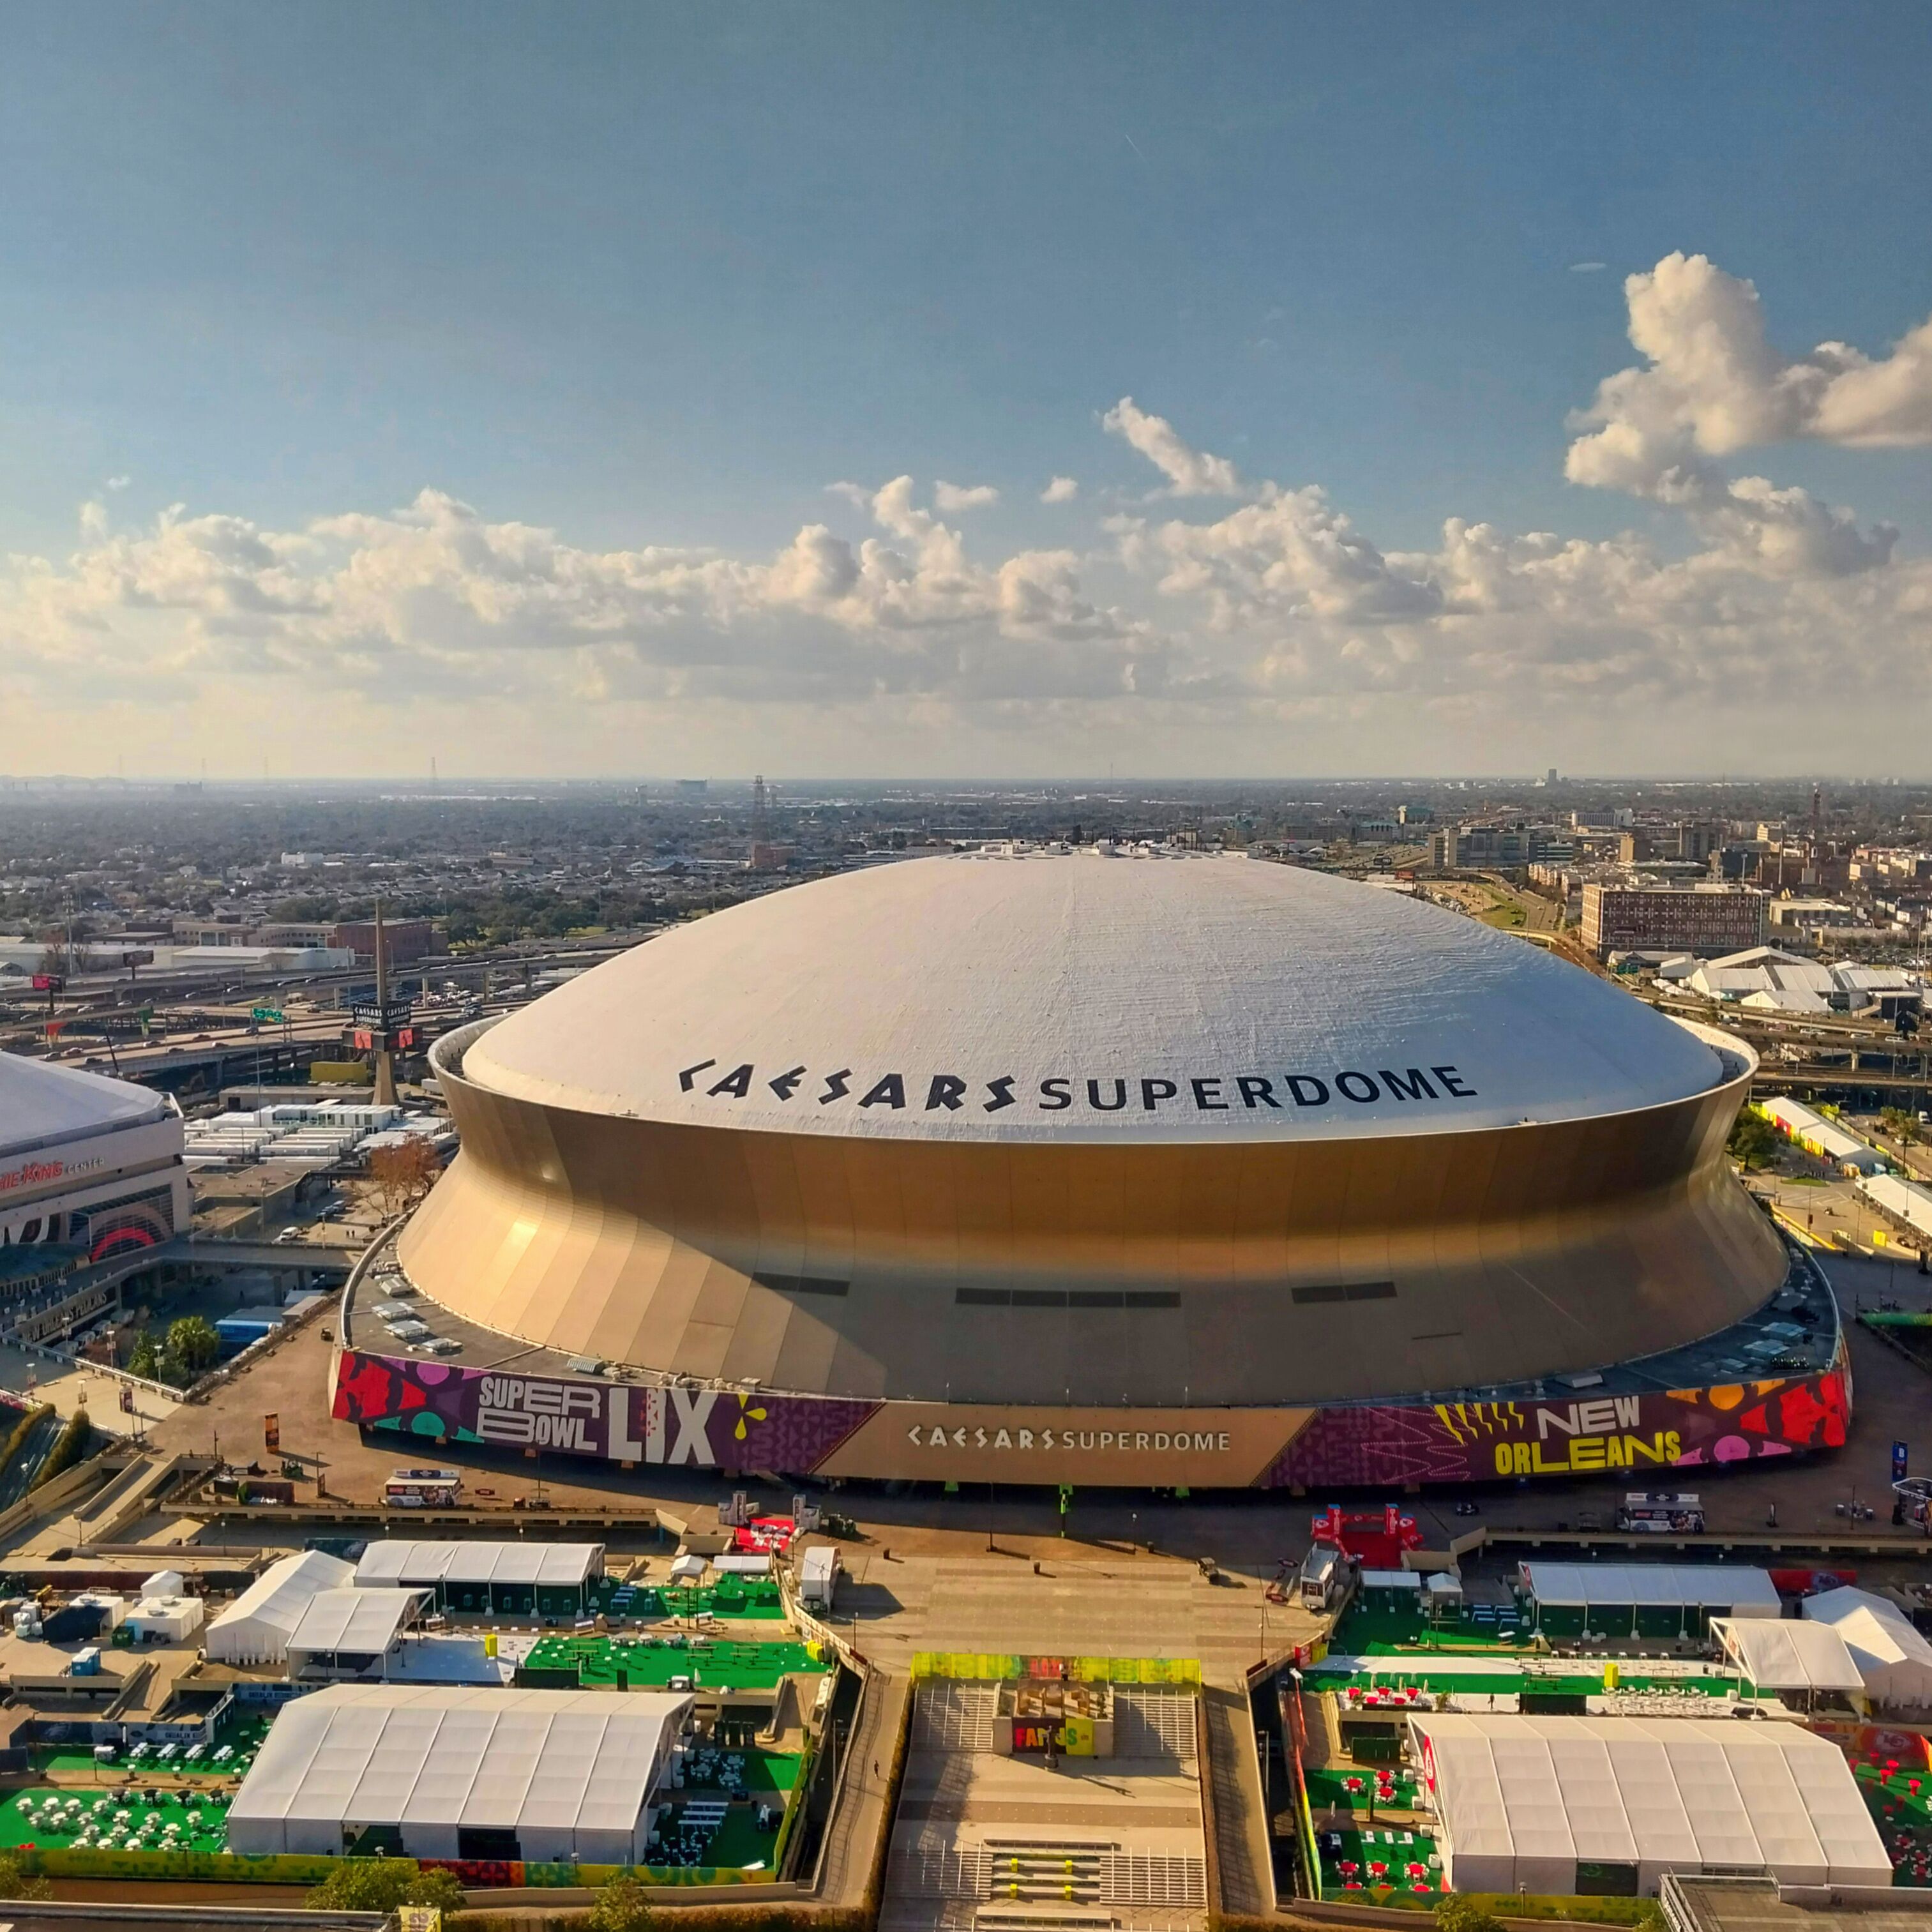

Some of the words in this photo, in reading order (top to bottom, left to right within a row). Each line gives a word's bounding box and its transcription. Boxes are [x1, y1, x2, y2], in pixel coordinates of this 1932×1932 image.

[354, 1007, 382, 1016] CAESARS
[678, 1058, 1017, 1113] CAESARS
[1039, 1066, 1478, 1111] SUPERDOME
[68, 1158, 105, 1174] CENTER
[479, 1376, 601, 1419] SUPER
[1537, 1395, 1640, 1439] NEW
[476, 1407, 598, 1451] BOWL
[608, 1387, 720, 1465] LIX
[908, 1425, 1054, 1450] CAESARS
[1062, 1430, 1230, 1451] SUPERDOME
[1495, 1430, 1680, 1475] ORLEANS
